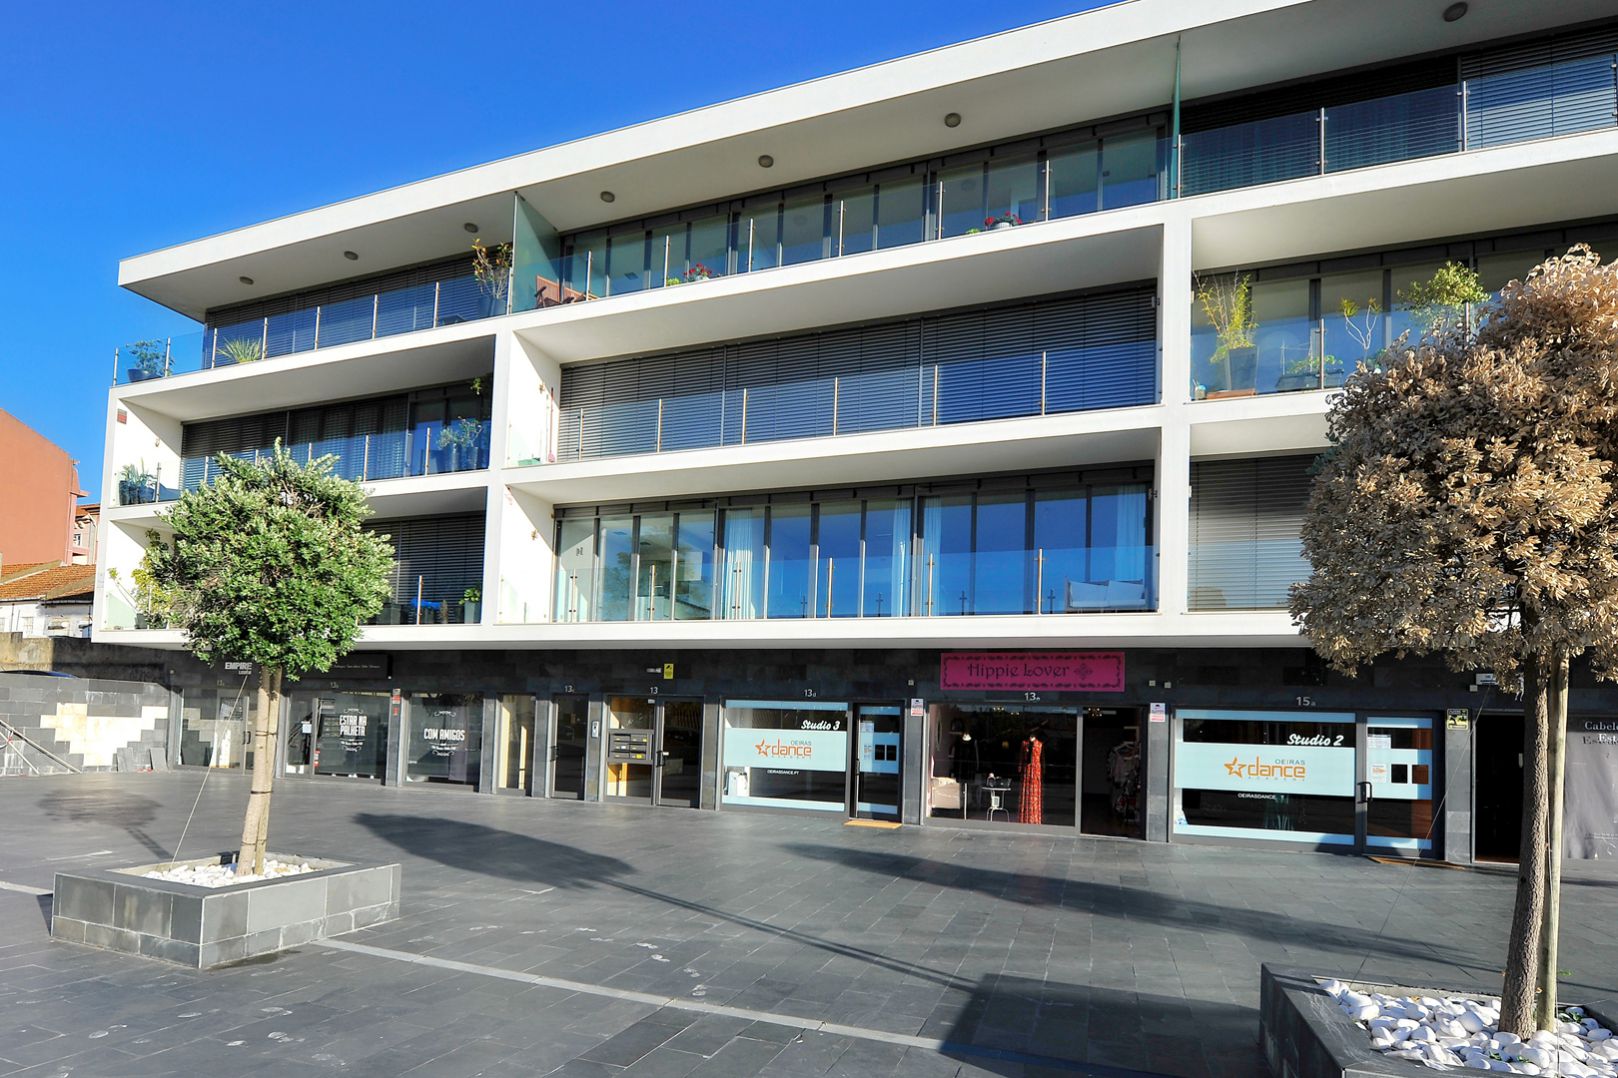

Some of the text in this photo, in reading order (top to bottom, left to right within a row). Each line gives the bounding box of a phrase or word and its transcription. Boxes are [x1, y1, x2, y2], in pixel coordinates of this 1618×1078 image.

[225, 662, 253, 670] EMPIRE
[967, 662, 1070, 679] Hippie Lover
[650, 686, 658, 695] 13
[339, 715, 358, 726] ESTAR
[801, 719, 841, 731] Studio 3
[423, 728, 465, 741] COM AMIGOS
[1287, 733, 1345, 746] Studio 2
[771, 738, 812, 757] dance
[1247, 755, 1306, 778] dance
